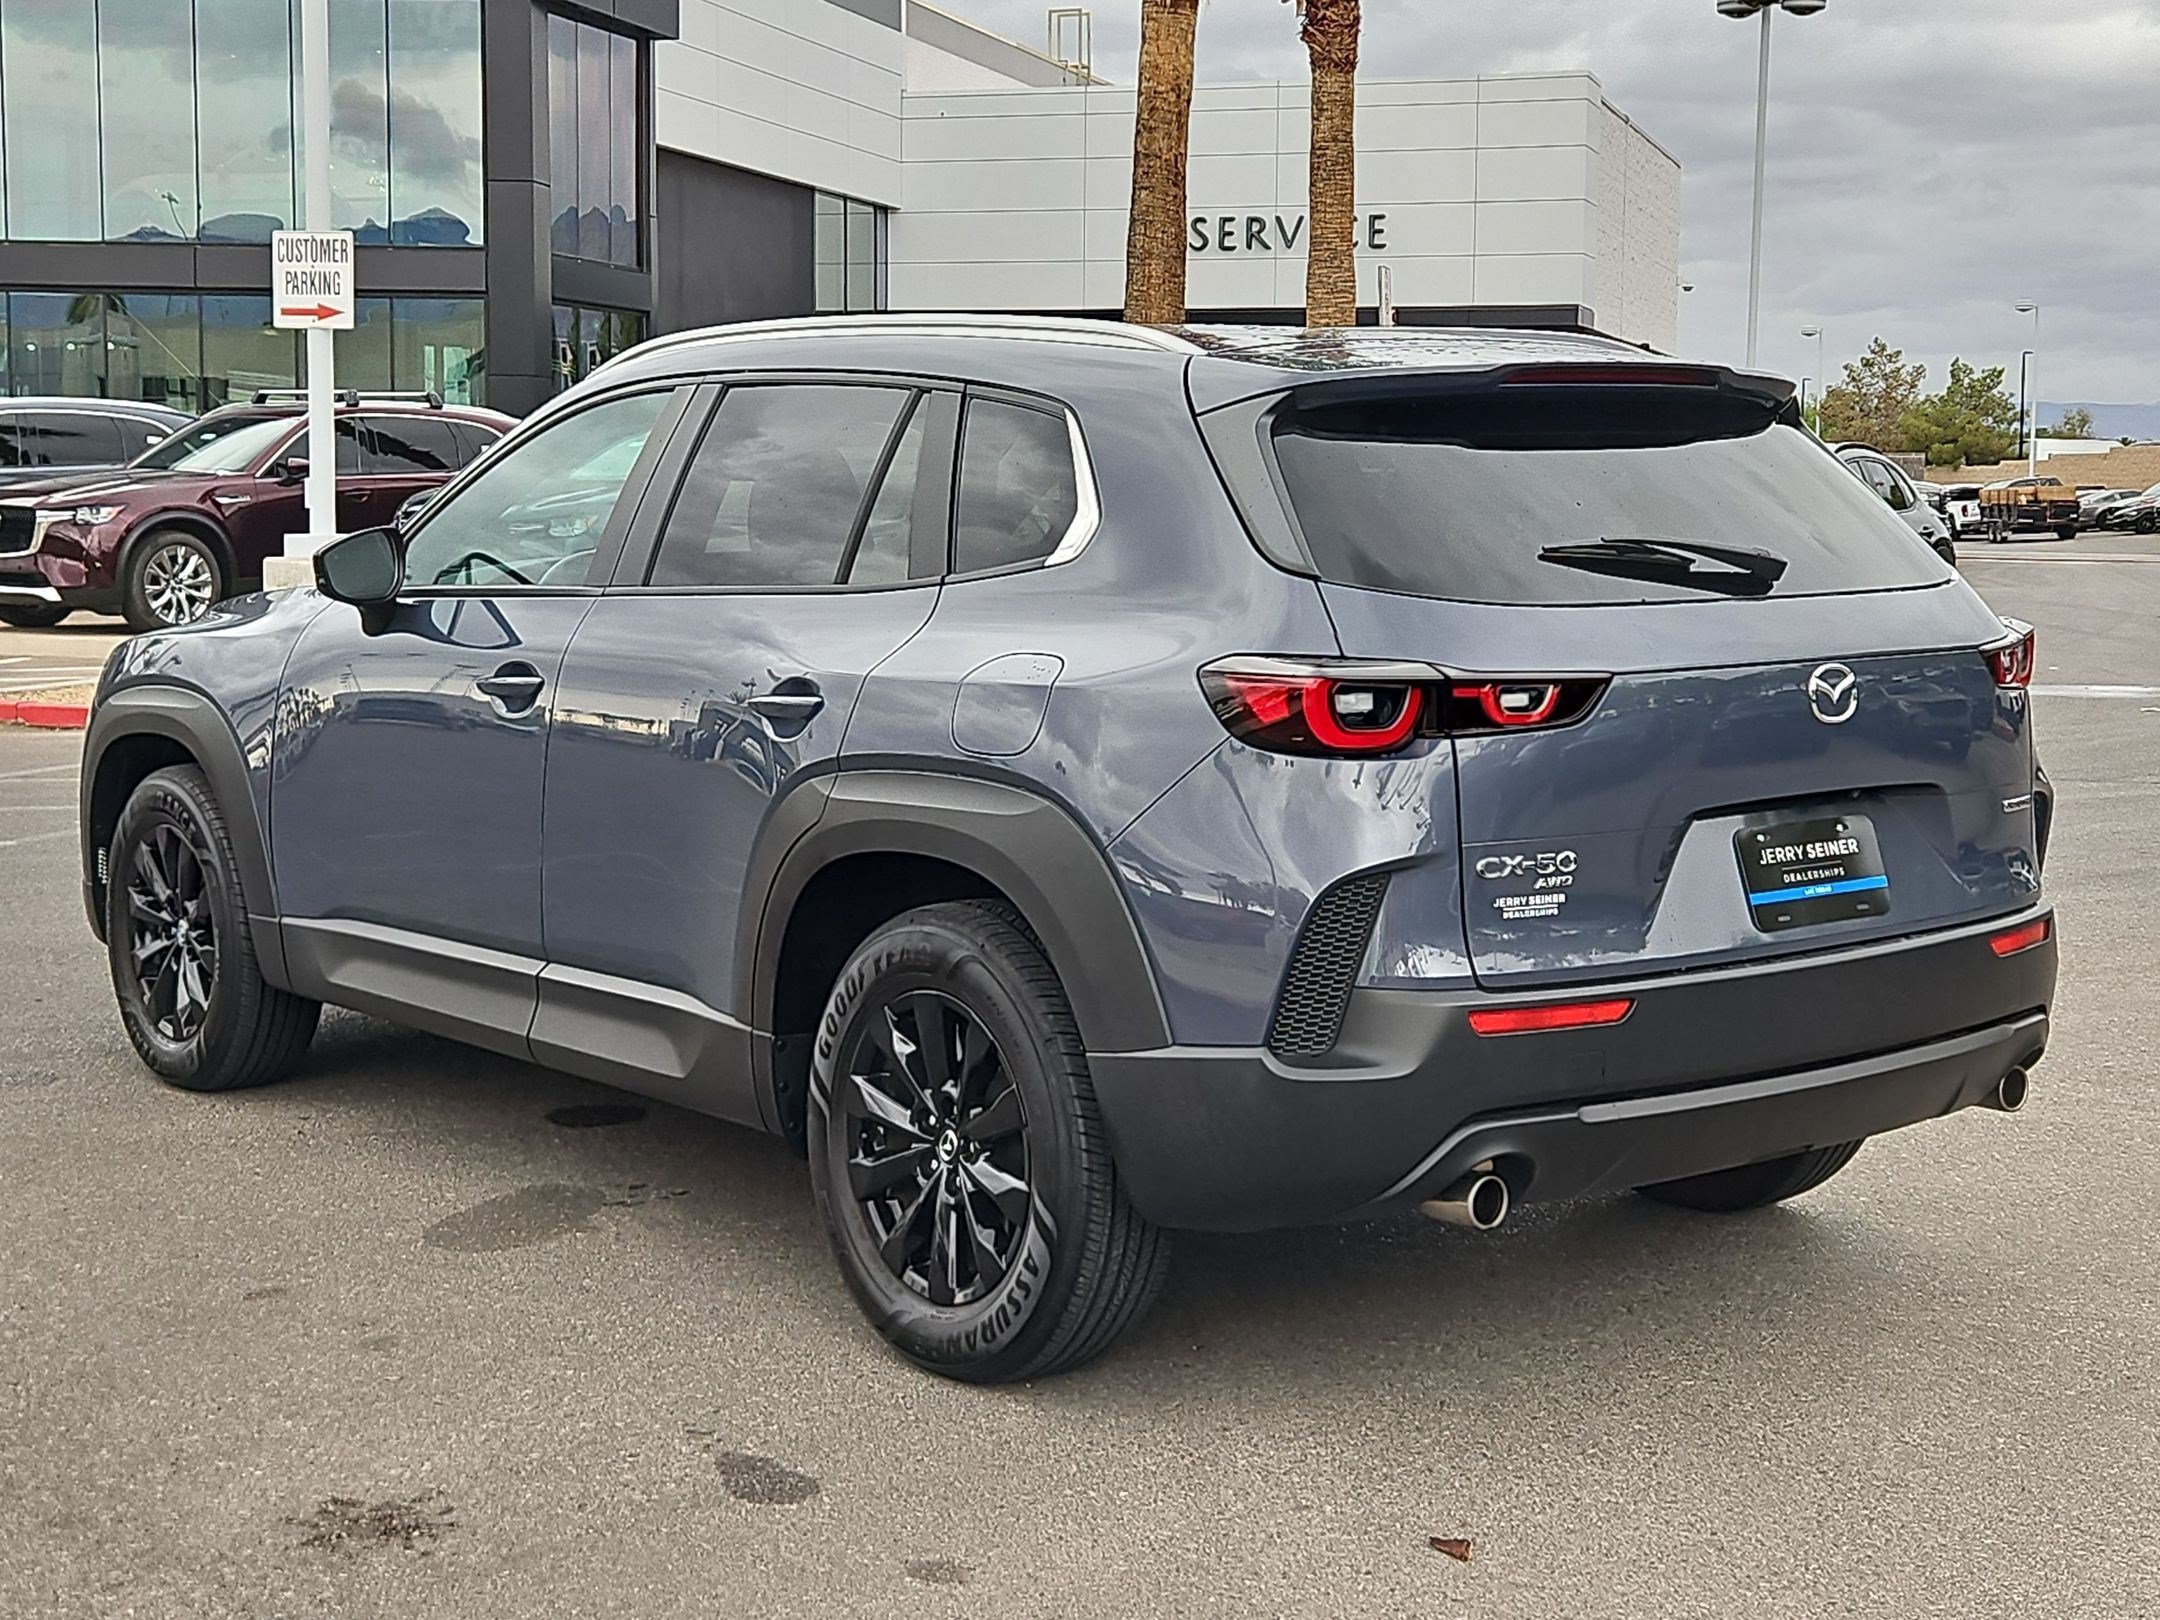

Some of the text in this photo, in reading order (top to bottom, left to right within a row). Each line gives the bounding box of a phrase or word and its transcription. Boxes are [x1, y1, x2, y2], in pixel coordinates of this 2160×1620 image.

[1188, 214, 1388, 251] SERVE
[277, 237, 348, 263] CUSTOMER
[285, 270, 341, 296] PARKING
[1759, 837, 1860, 865] JERRY SEINER
[1475, 850, 1578, 879] CX-50
[1783, 866, 1846, 883] DEALERSHIPS
[1533, 875, 1574, 890] AWD
[1492, 896, 1528, 908] JERRY
